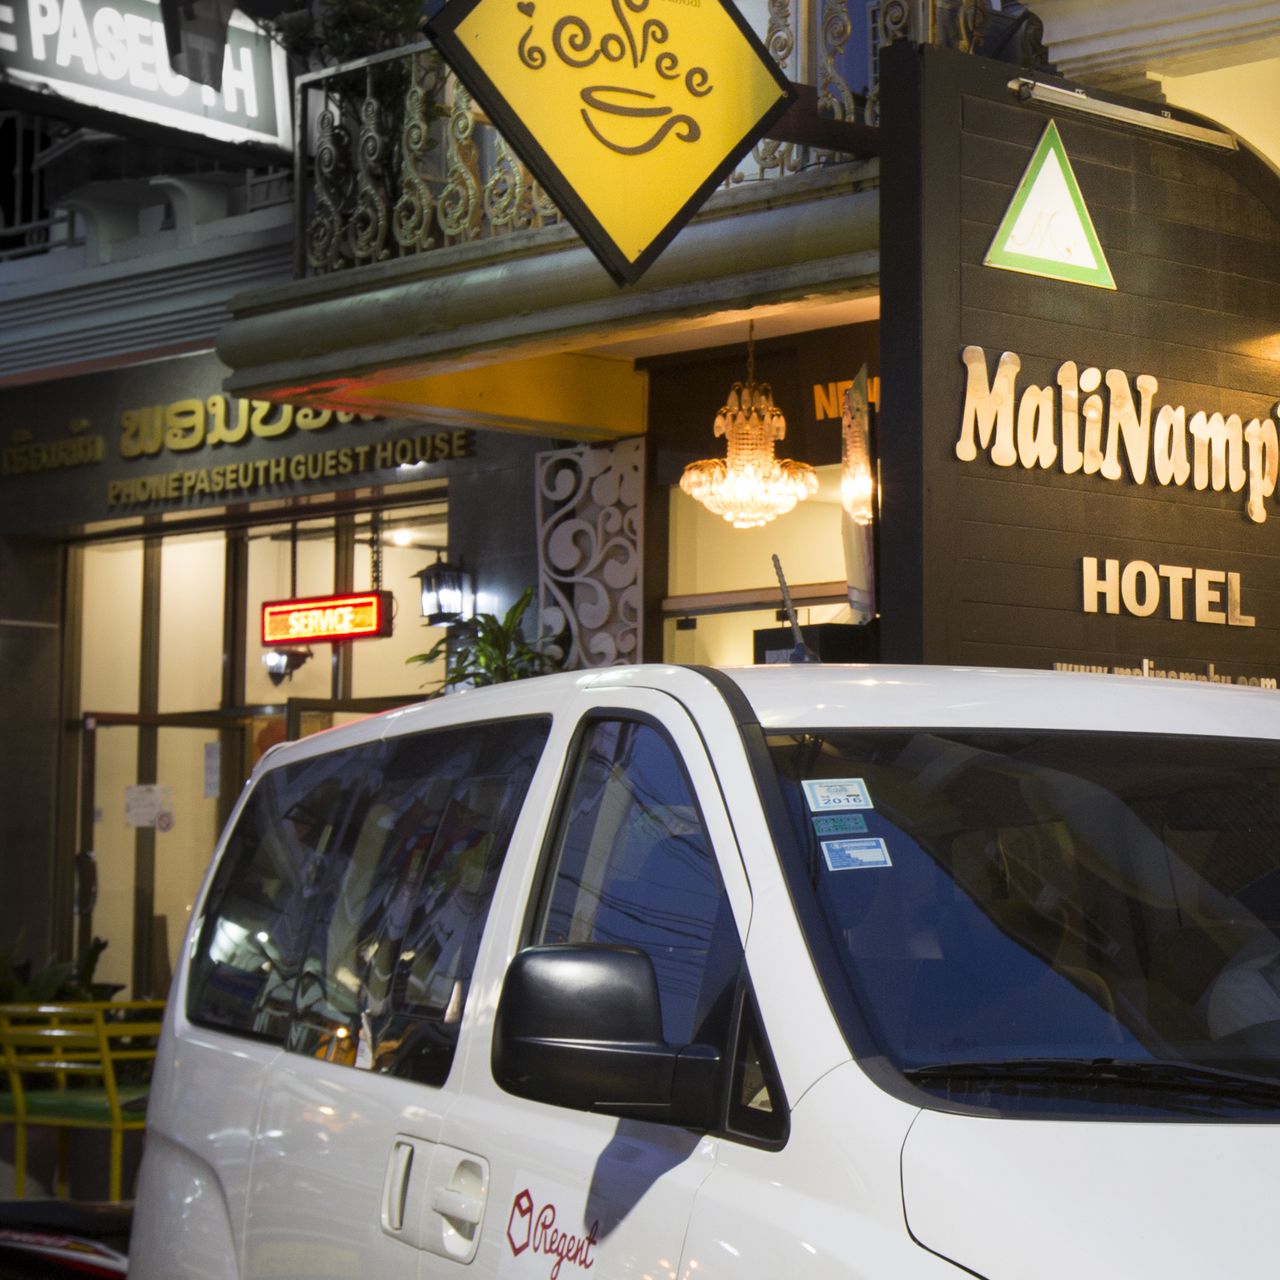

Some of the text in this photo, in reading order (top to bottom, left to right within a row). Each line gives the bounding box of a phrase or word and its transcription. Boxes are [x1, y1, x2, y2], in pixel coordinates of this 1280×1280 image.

[290, 445, 369, 481] GUEST
[374, 429, 467, 468] HOUSE
[1082, 556, 1256, 627] HOTEL
[823, 797, 863, 805] 2016
